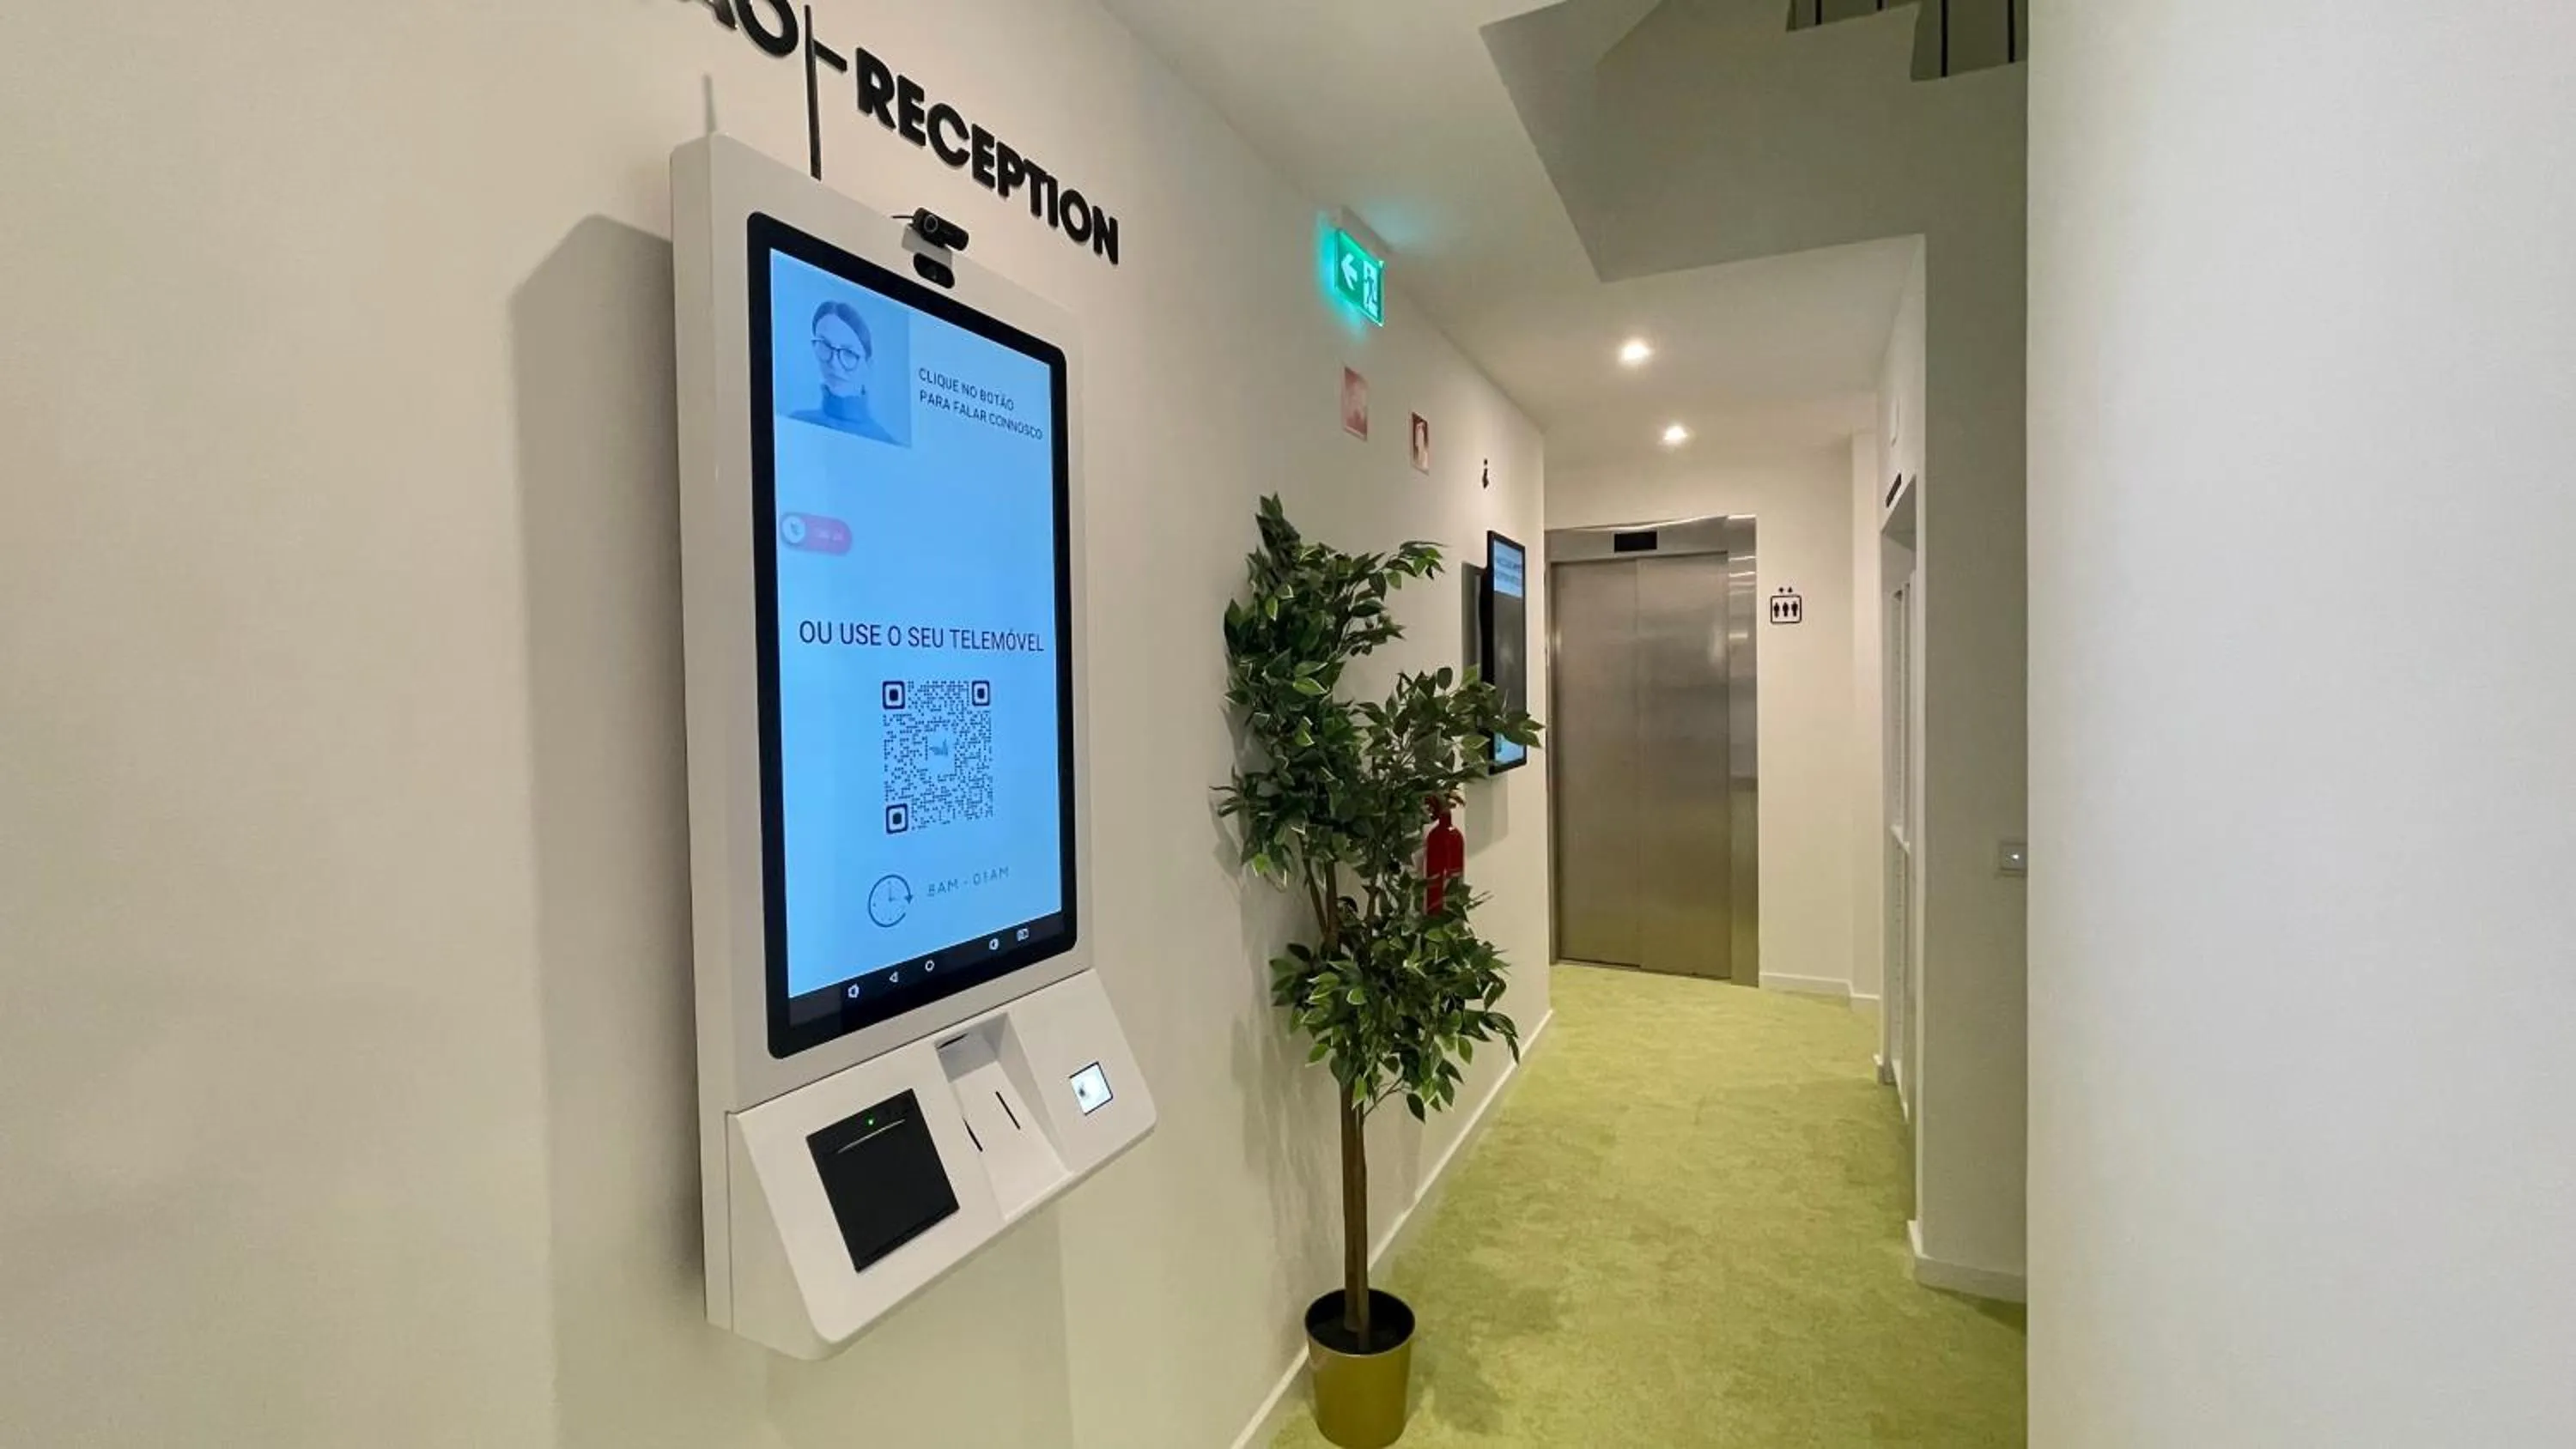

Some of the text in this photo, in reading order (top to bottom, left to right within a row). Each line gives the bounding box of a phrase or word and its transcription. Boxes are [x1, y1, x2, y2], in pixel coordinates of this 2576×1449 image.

[856, 47, 1119, 264] RECEPTION
[919, 367, 959, 393] CLIQUE
[961, 382, 978, 399] NO
[920, 389, 1043, 440] PARA FALAR CONNOSCO
[799, 621, 1044, 652] OU USE O SEU TELEMÓVEL
